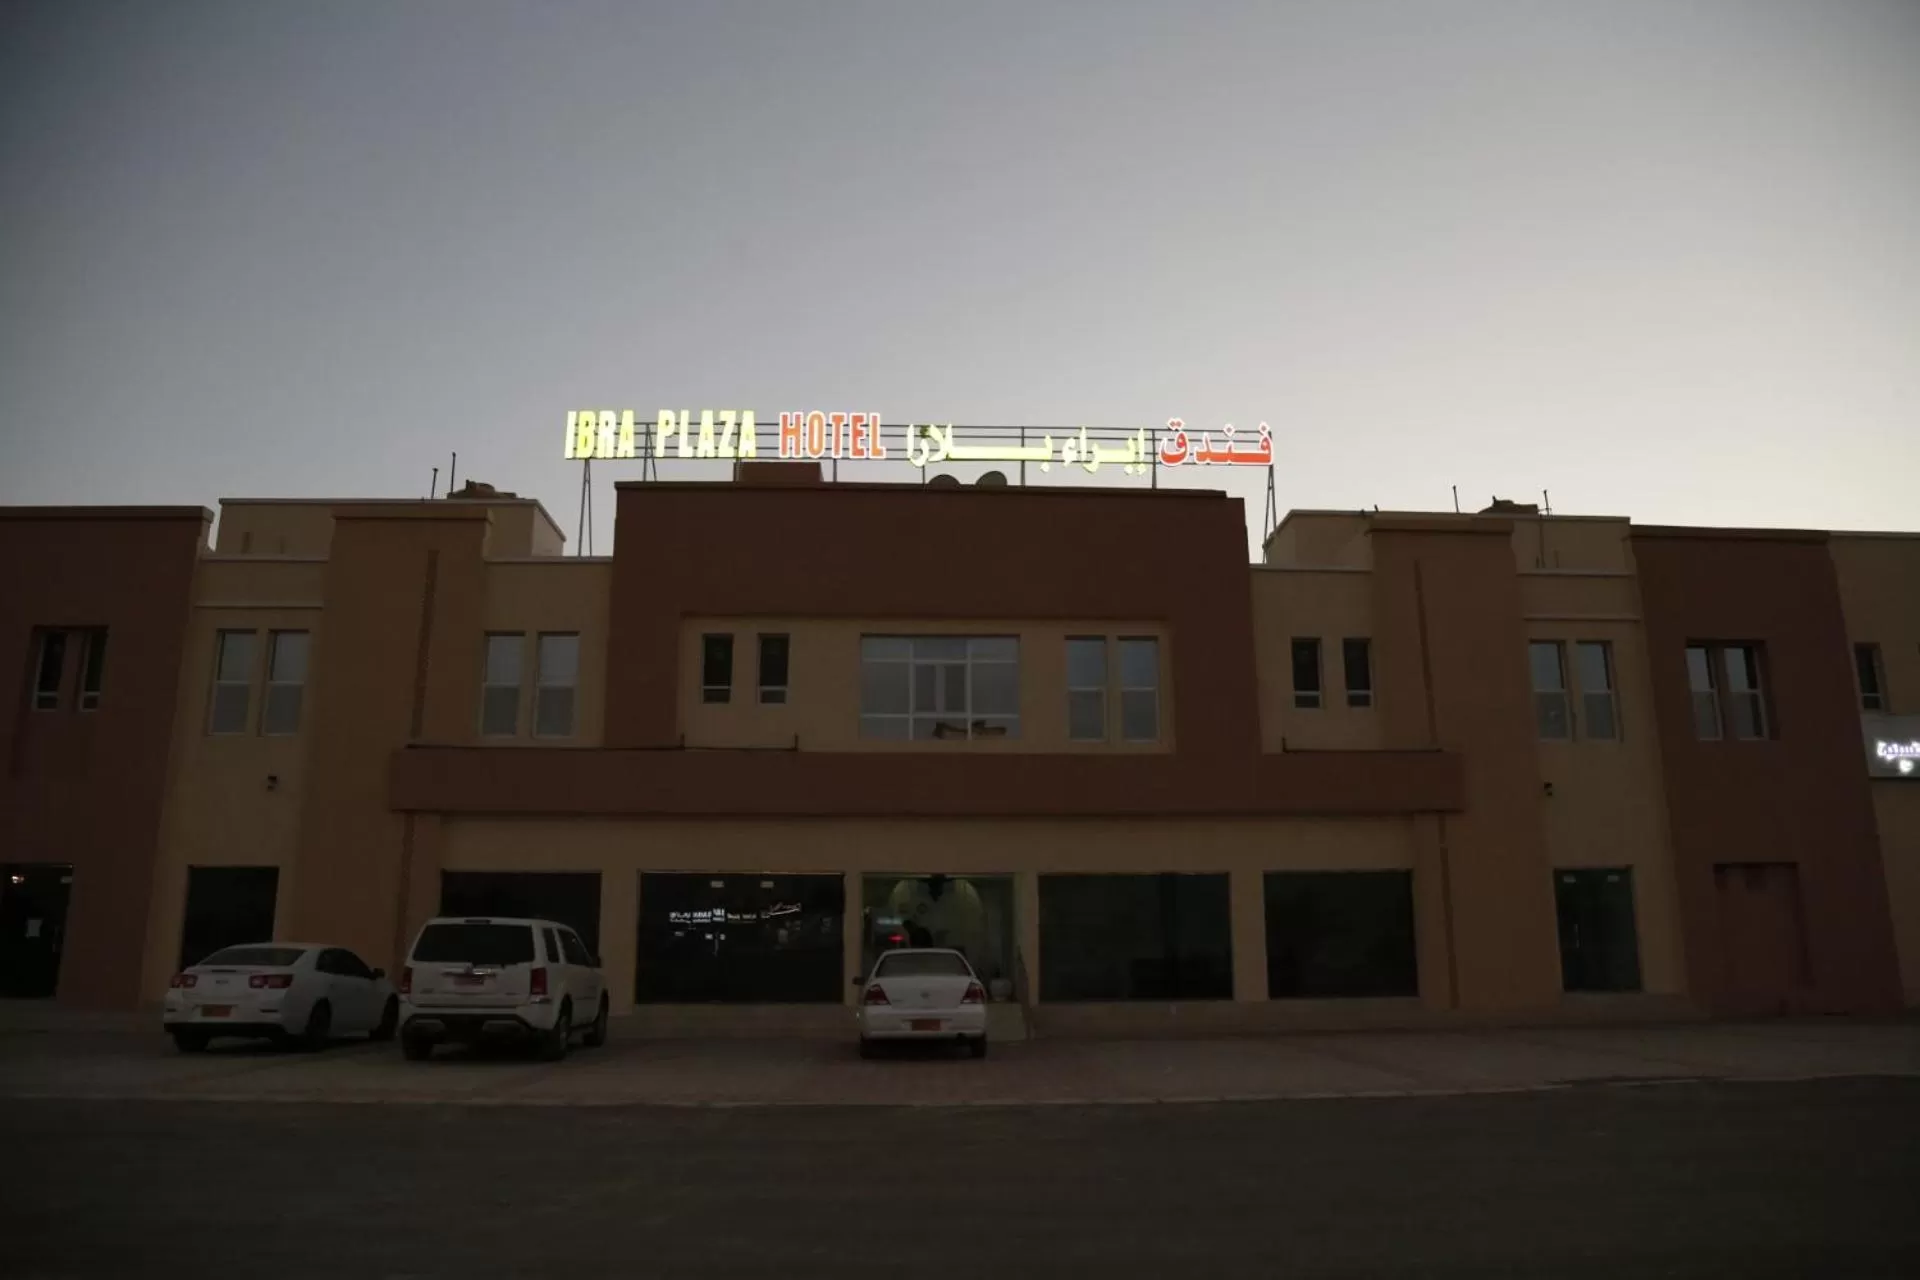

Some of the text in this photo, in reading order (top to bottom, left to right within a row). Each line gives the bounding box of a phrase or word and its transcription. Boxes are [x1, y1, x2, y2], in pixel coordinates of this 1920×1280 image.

[564, 410, 887, 459] IBRA PLAZA HOTEL
[1158, 417, 1274, 467] فندق
